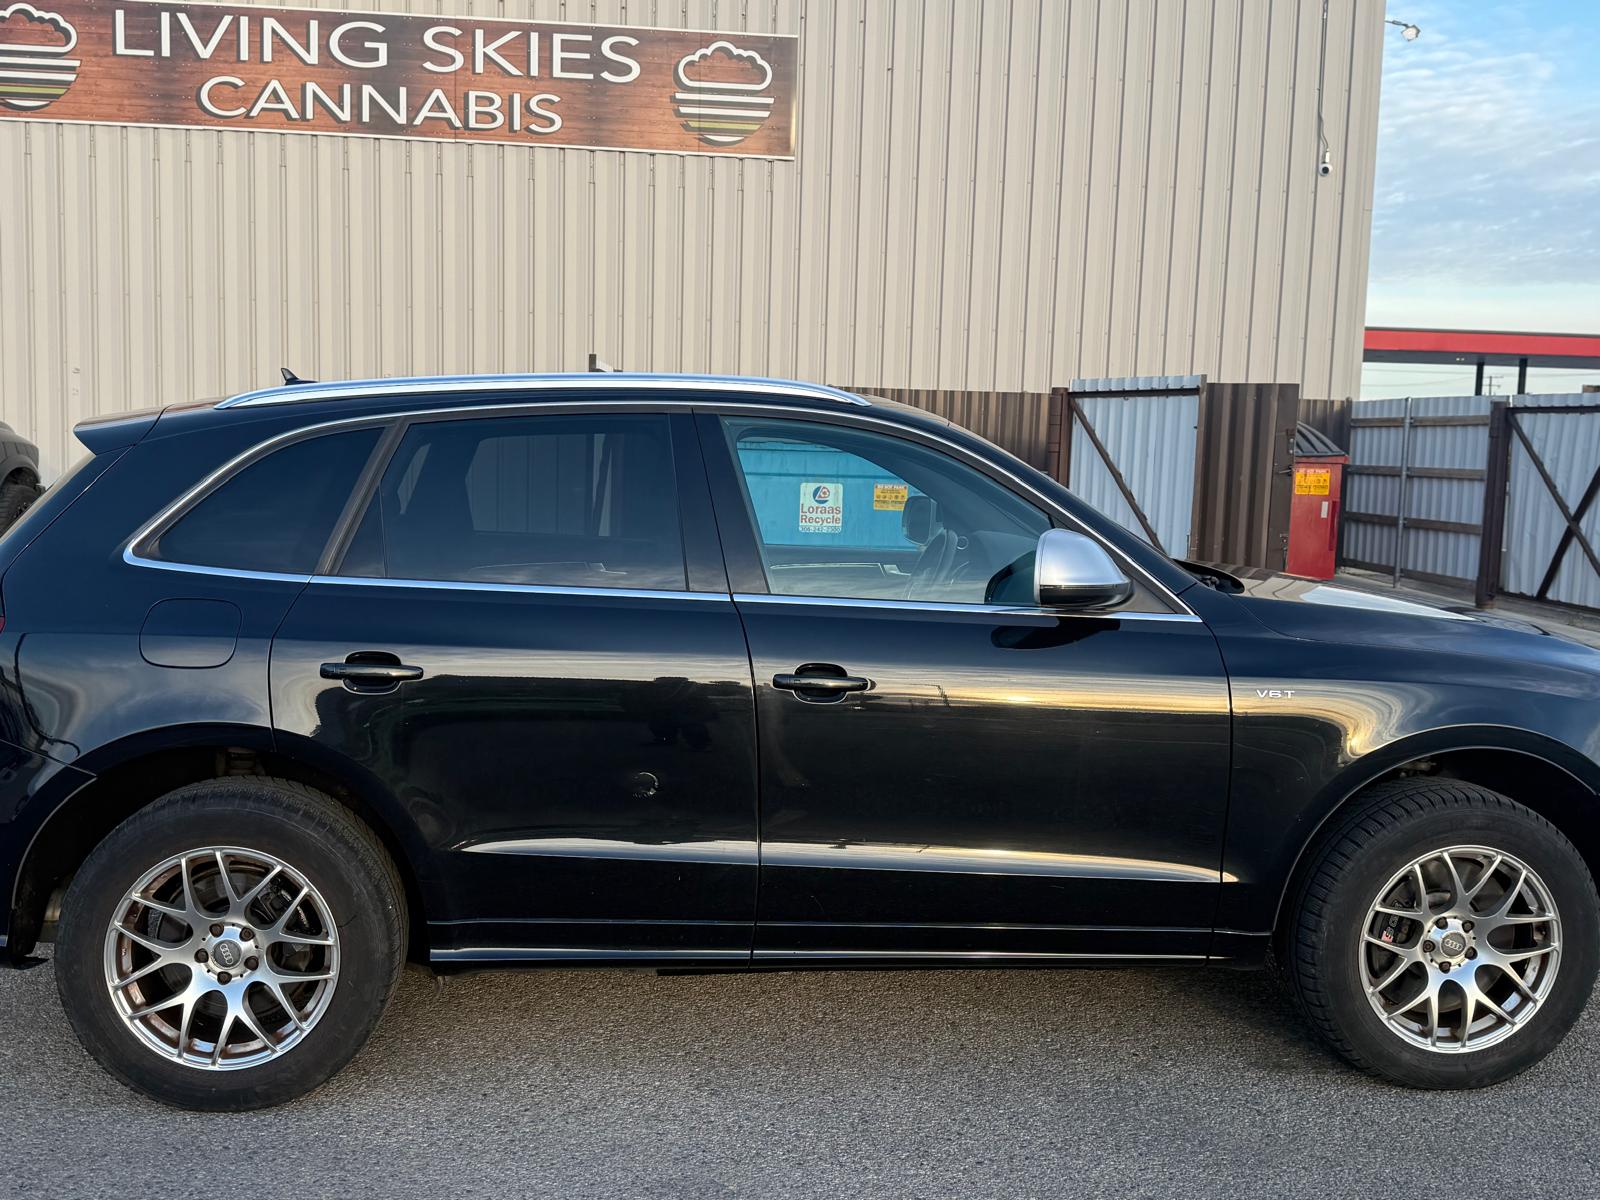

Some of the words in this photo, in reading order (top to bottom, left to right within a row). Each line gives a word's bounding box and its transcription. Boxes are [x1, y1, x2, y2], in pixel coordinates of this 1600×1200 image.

[113, 9, 389, 69] LIVING
[421, 25, 641, 84] SKIES
[198, 75, 563, 134] CANNABIS
[800, 503, 841, 515] Loraas
[800, 515, 841, 525] Recycle
